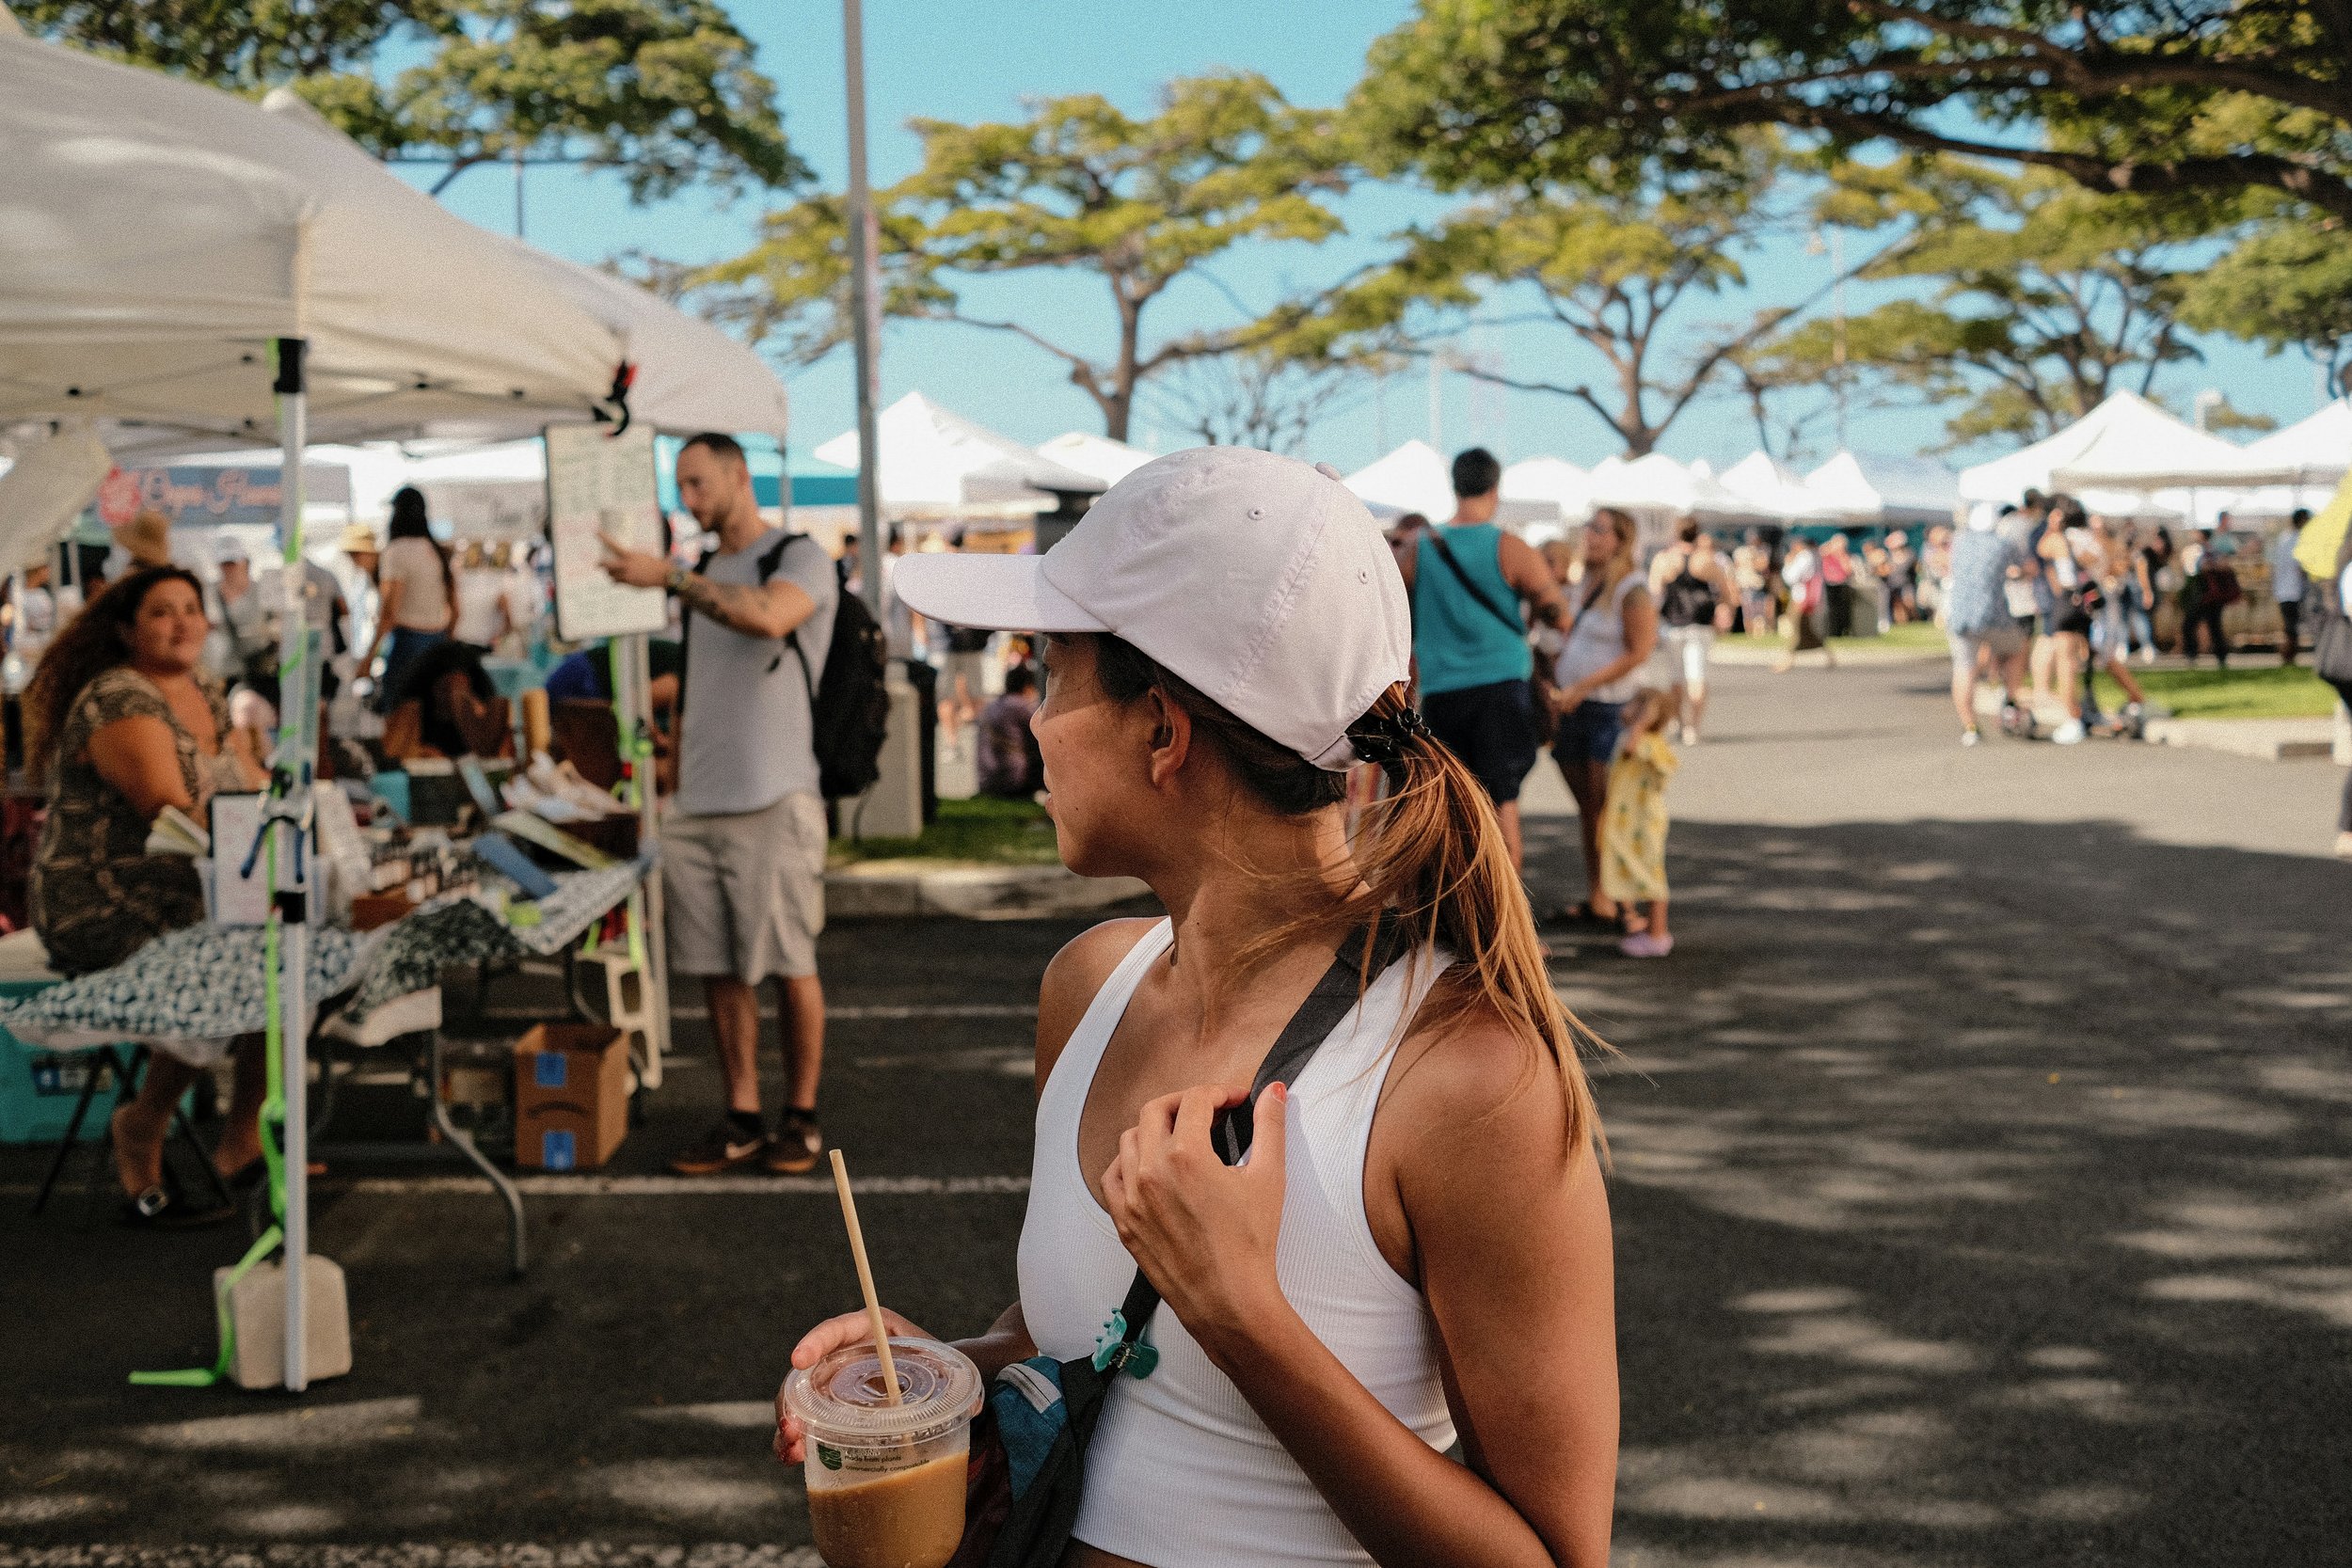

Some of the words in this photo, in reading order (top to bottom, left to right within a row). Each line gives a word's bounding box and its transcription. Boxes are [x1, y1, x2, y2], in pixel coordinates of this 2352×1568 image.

[881, 1455, 901, 1464] plants
[846, 1465, 888, 1473] commercially
[890, 1459, 930, 1471] compostable
